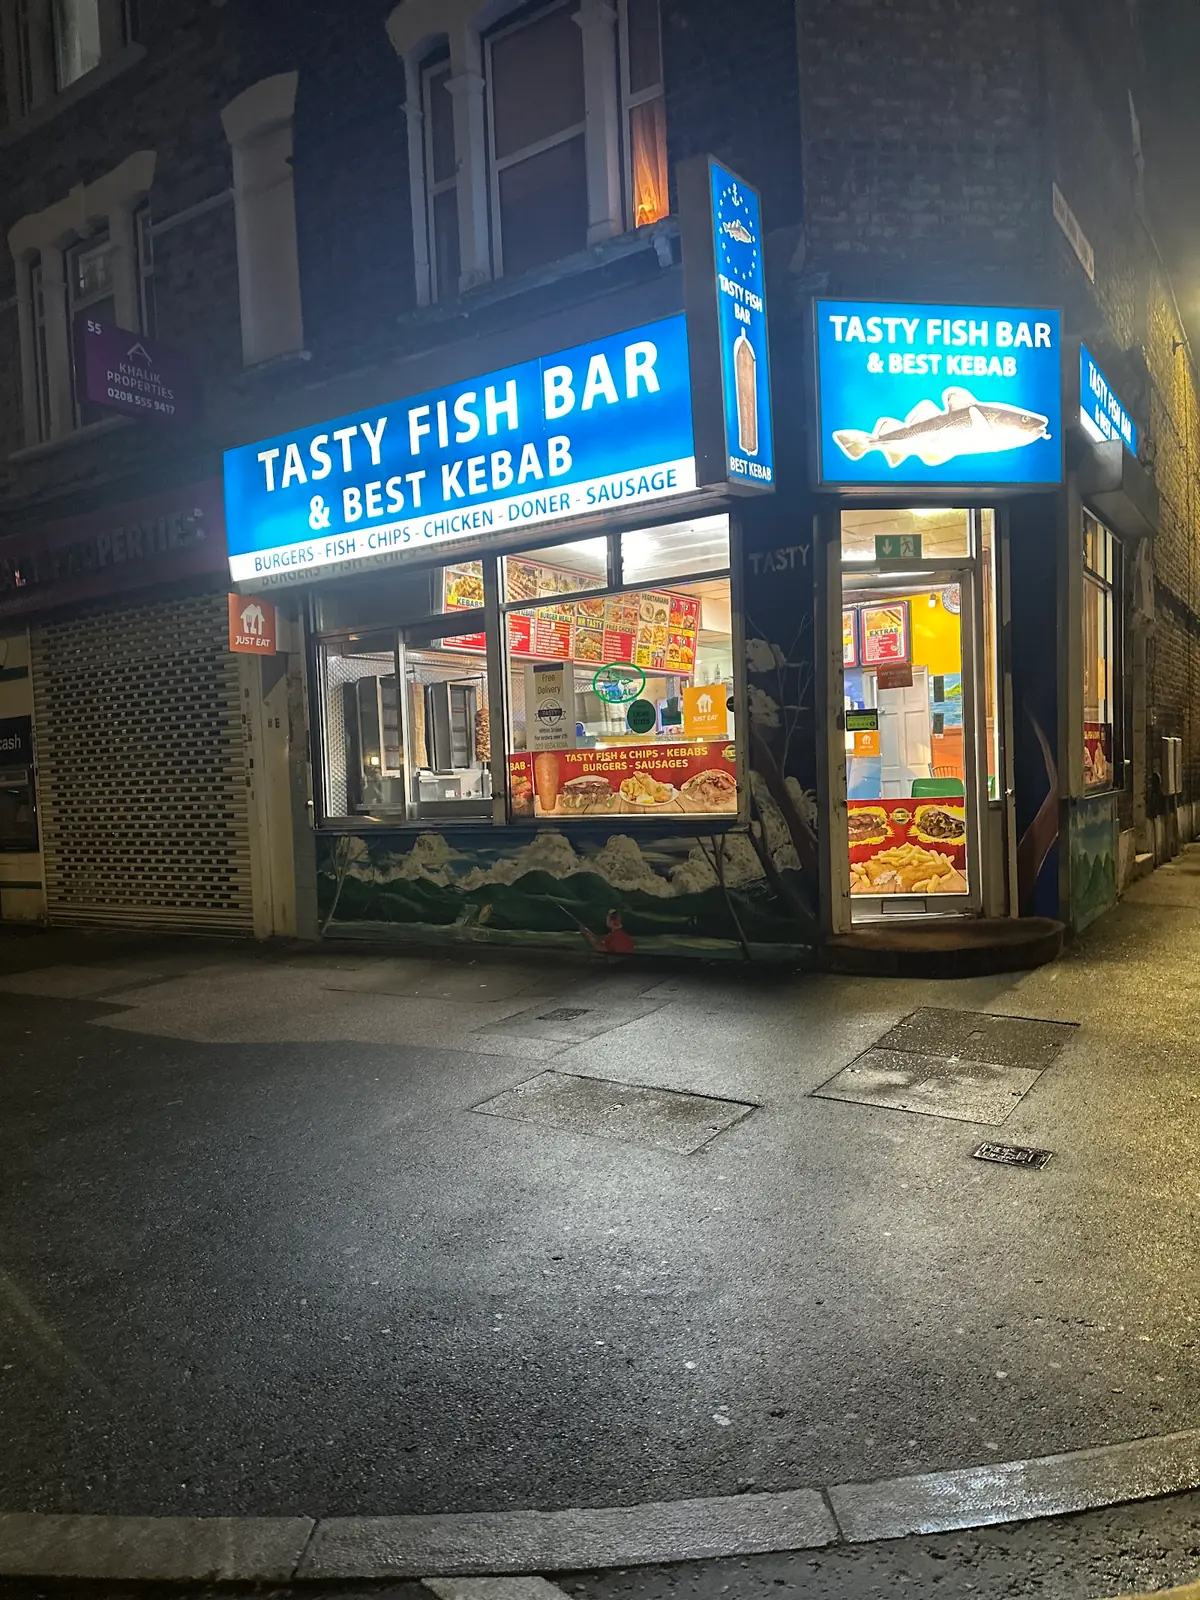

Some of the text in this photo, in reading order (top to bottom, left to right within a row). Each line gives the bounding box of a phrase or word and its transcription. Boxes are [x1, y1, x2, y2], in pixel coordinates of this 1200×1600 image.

[718, 274, 763, 312] TASTY FISH
[734, 302, 751, 325] BAR
[87, 319, 102, 335] 55
[829, 315, 1052, 348] TASTY FISH BAR
[119, 362, 162, 384] KHALIK
[866, 352, 1017, 377] & BEST KEBAB
[107, 370, 174, 400] PROPERTIES
[1089, 360, 1108, 408] TASTY
[107, 387, 133, 403] 0208
[135, 395, 152, 409] 555
[257, 340, 661, 492] TASTY FISH BAR
[730, 455, 772, 481] BEST KEBAB
[307, 435, 573, 531] & BEST KEBAB
[254, 545, 315, 572] BURGERS
[325, 537, 356, 559] FISH
[367, 526, 411, 550] CHIPS
[424, 509, 493, 538] CHICKEN
[508, 492, 570, 522] DONER
[586, 468, 678, 506] SAUSAGE
[748, 544, 810, 576] TASTY
[456, 597, 484, 608] KEBABS
[235, 635, 271, 648] JUST EAT
[869, 627, 899, 636] EXTRAS
[541, 673, 556, 682] Free
[537, 685, 561, 695] Delivery
[692, 715, 706, 723] JUST
[565, 753, 595, 763] TASTY
[596, 751, 618, 762] FISH
[619, 751, 627, 761] &
[629, 749, 659, 760] CHIPS
[666, 747, 708, 757] KEBABS
[582, 761, 628, 772] BURGERS
[634, 758, 689, 770] SAUSAGES
